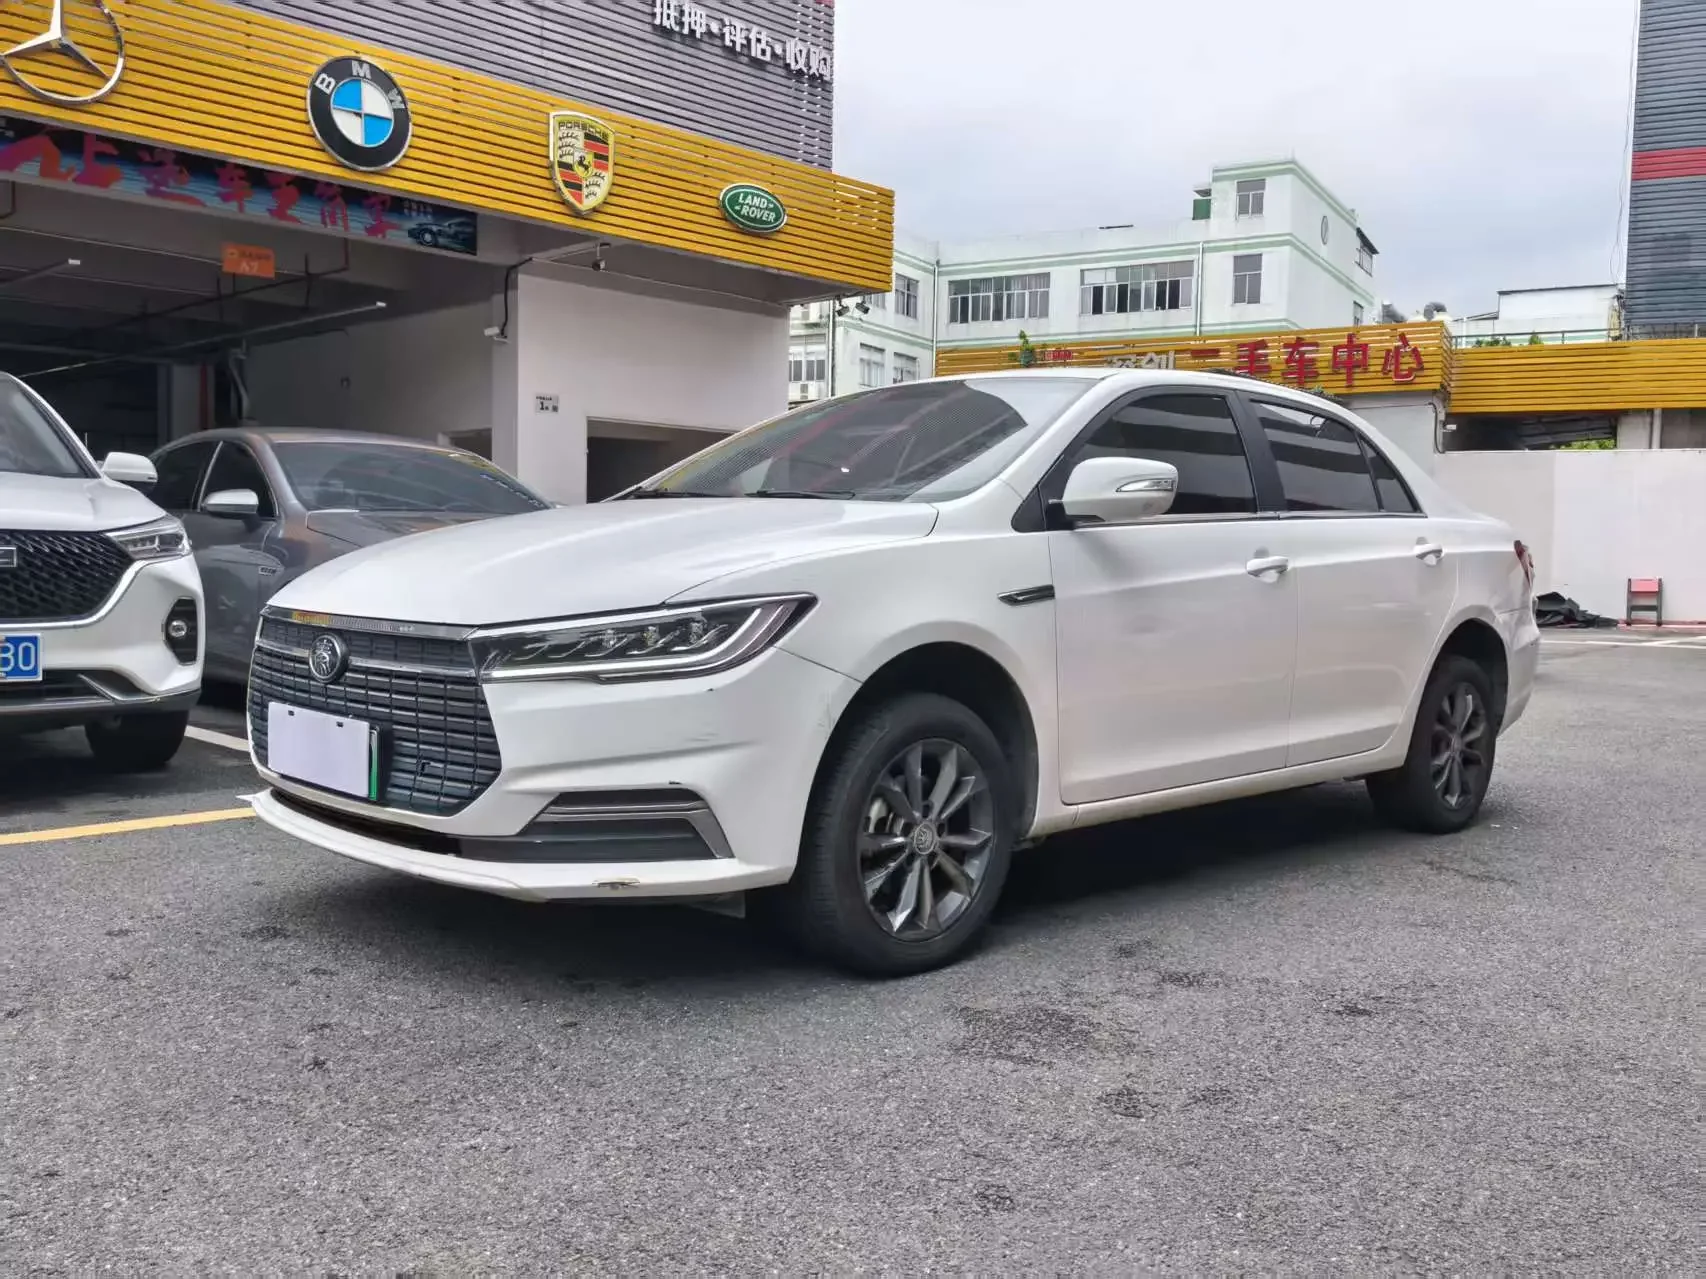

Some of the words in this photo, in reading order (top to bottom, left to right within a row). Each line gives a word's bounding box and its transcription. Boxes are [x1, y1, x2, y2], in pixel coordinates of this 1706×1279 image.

[314, 60, 405, 109] BMW
[558, 120, 609, 140] PORSCHE
[738, 193, 768, 208] LAND
[740, 205, 776, 222] ROVER
